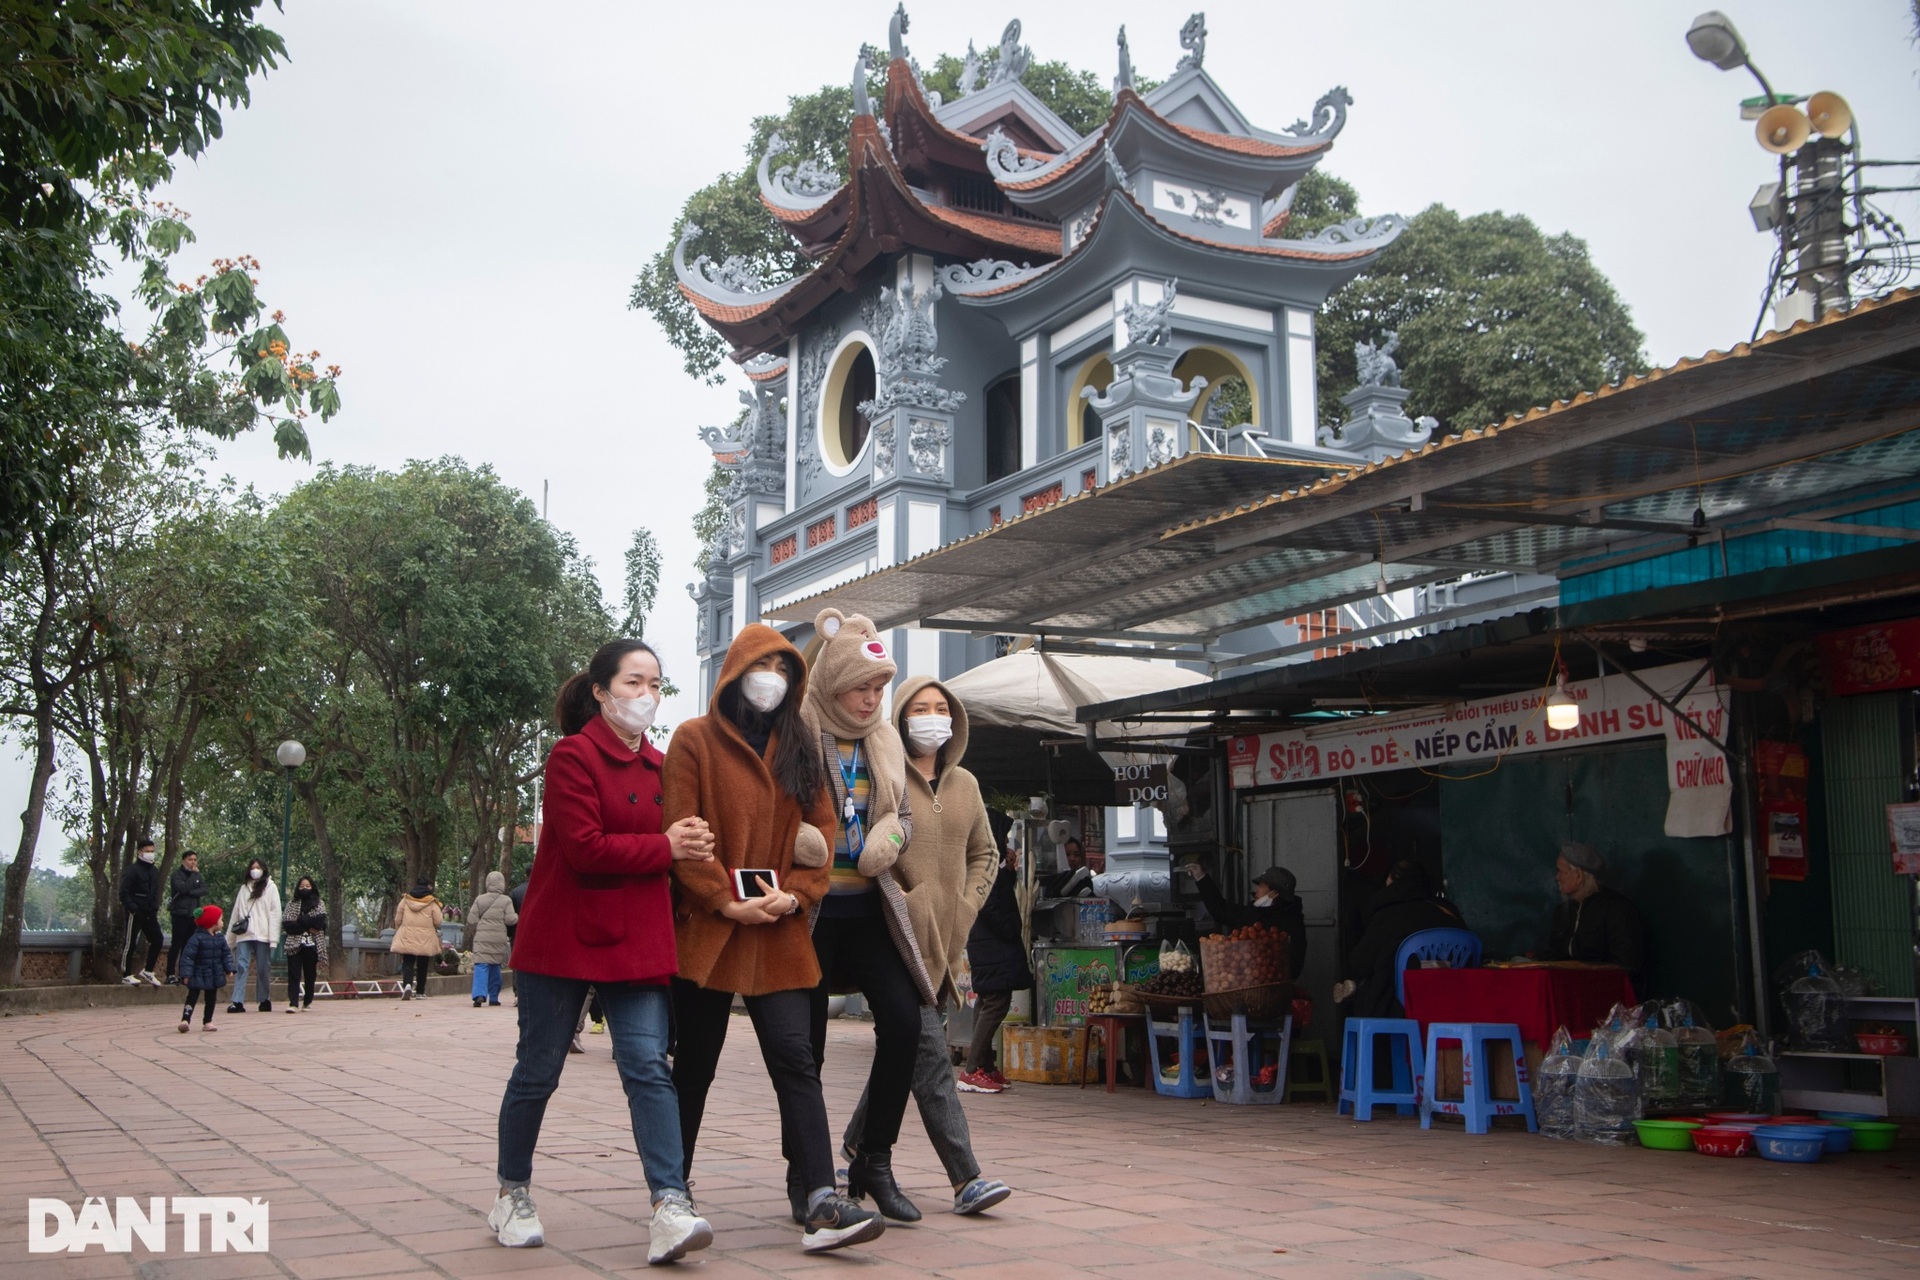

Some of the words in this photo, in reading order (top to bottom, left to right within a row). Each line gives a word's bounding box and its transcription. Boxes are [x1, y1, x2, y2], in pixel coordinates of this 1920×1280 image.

[1455, 707, 1479, 721] GIỚI
[1483, 699, 1519, 716] THIỆU
[1327, 745, 1355, 771] BÒ
[1415, 729, 1460, 760] NẾP
[1465, 718, 1519, 754] CẨM
[1525, 730, 1537, 745] &
[1113, 764, 1152, 782] HOT
[1128, 785, 1168, 802] DOG
